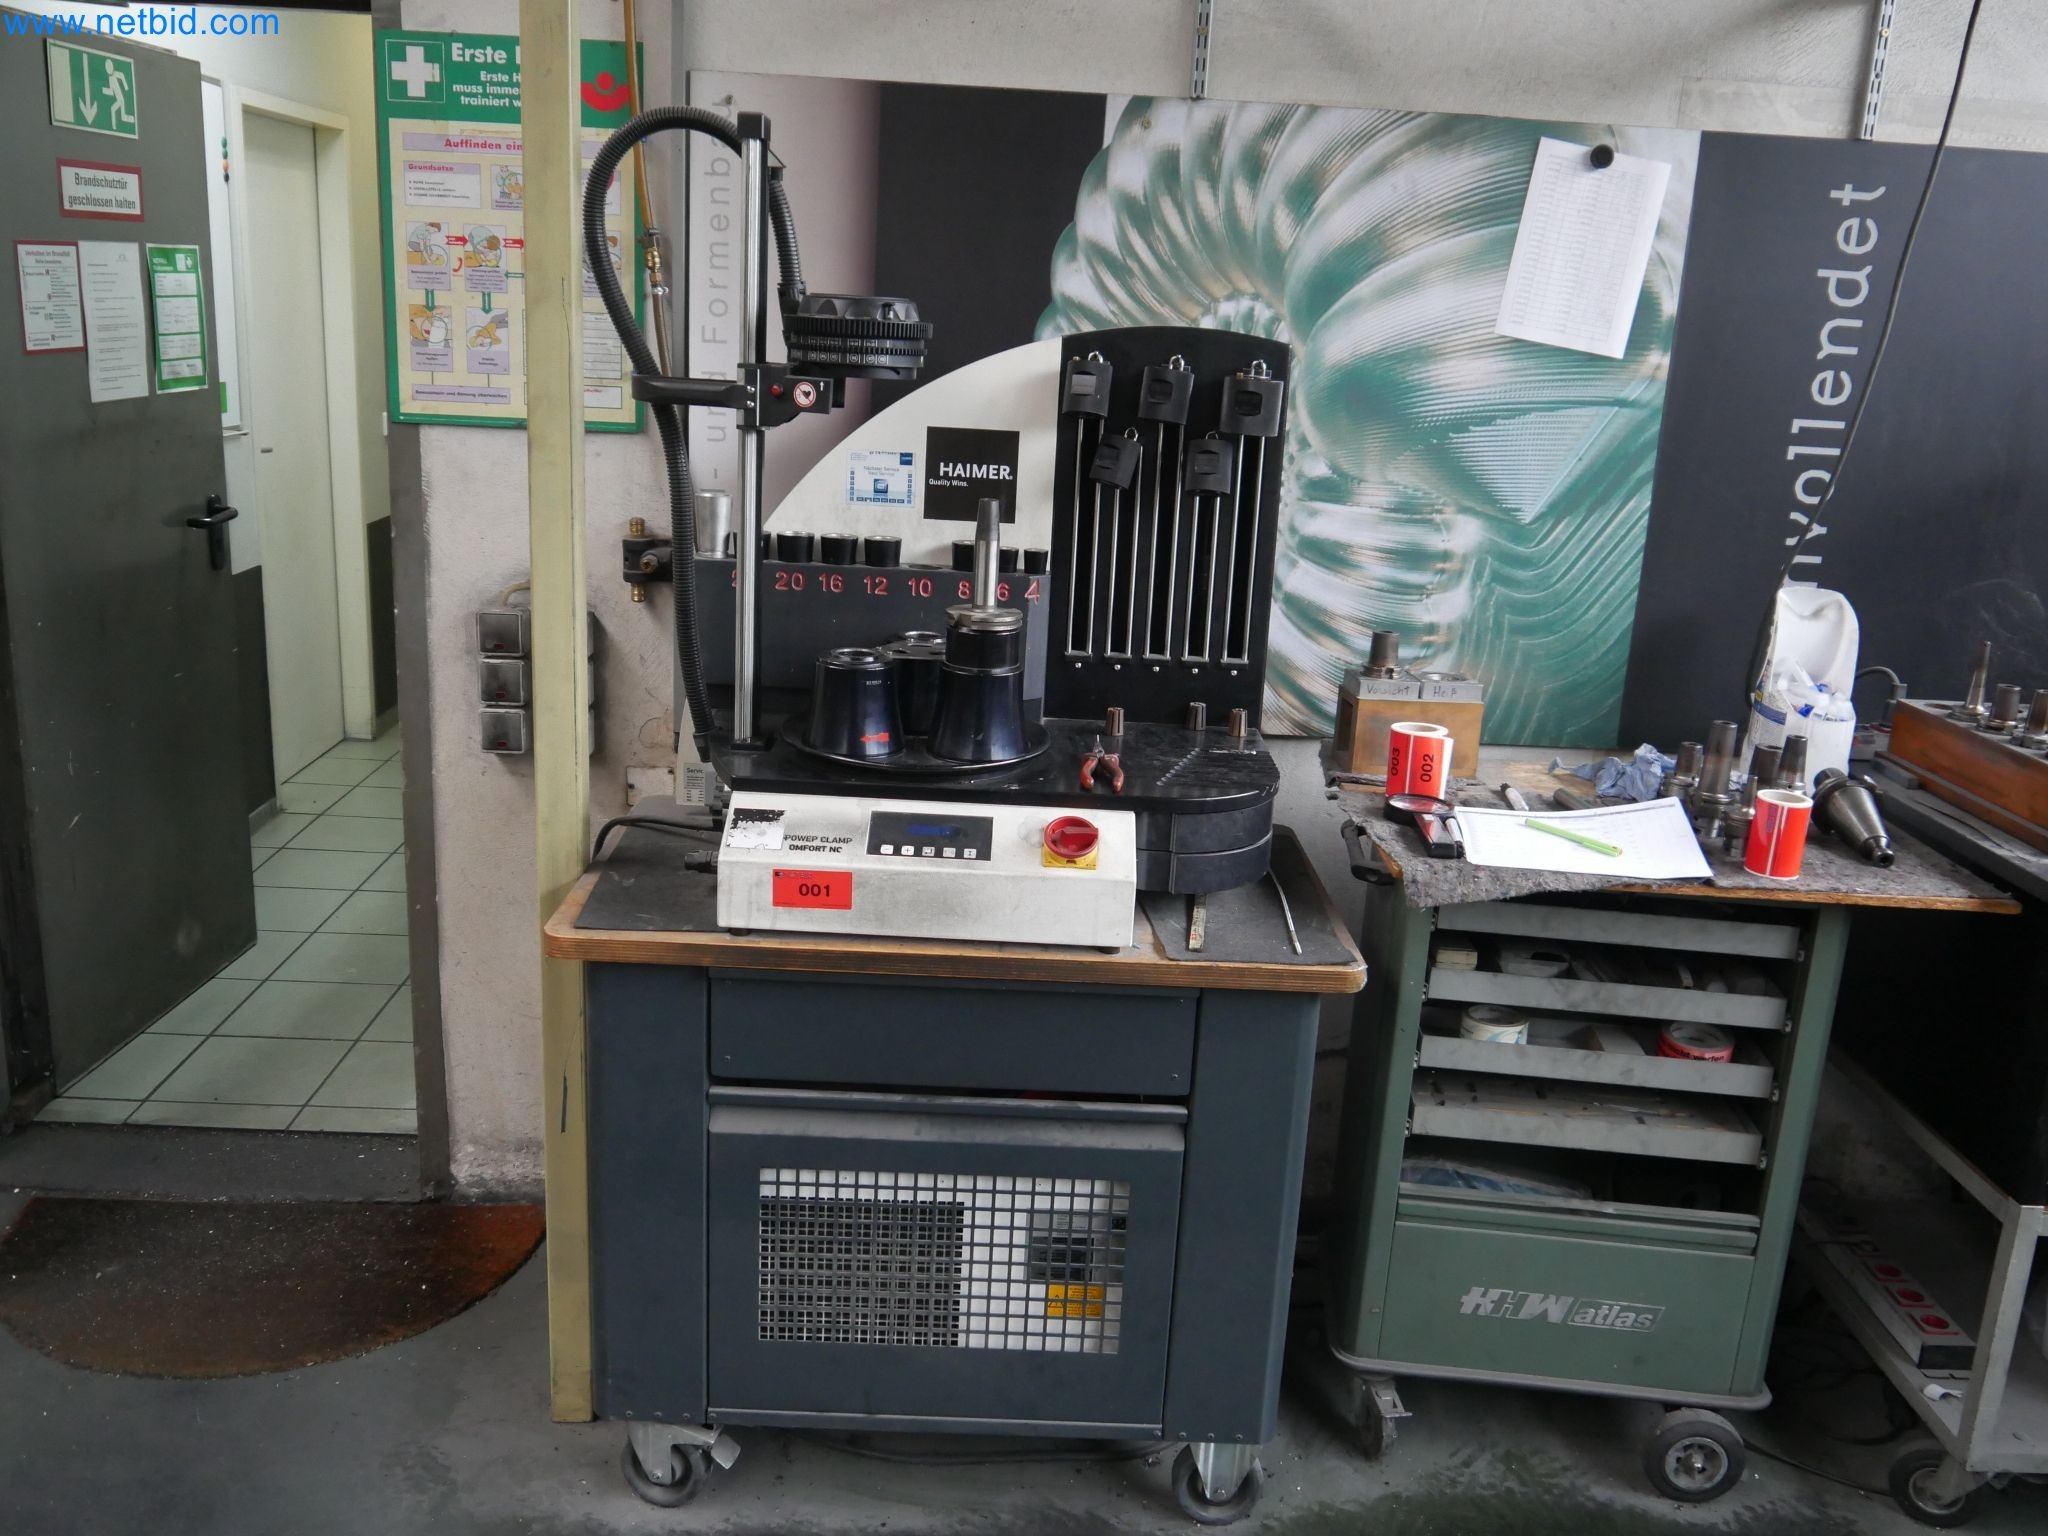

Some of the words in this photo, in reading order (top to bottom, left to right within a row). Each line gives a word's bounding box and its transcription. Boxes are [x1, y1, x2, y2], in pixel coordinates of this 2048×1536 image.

[451, 42, 508, 64] Erste
[480, 70, 510, 83] Erste
[452, 84, 484, 94] muss
[486, 83, 522, 95] imme
[460, 95, 510, 107] trainiert
[444, 138, 502, 150] Auffinden
[74, 171, 129, 190] Brandschutztür
[67, 193, 114, 208] geschlossen
[114, 196, 136, 210] halten
[928, 478, 951, 487] Quality
[951, 479, 969, 487] Wins.
[774, 569, 807, 592] 20
[818, 571, 845, 594] 16
[863, 574, 889, 596] 12
[908, 577, 933, 598] 10
[958, 579, 972, 600] 8
[996, 582, 1010, 602] 6
[1024, 577, 1041, 606] 4
[1366, 684, 1411, 697] Vosicht
[1390, 746, 1401, 777] 003
[1420, 753, 1434, 783] 002
[820, 836, 853, 845] CLAMP
[788, 845, 827, 853] OMFORT
[828, 845, 843, 854] NC
[798, 883, 831, 897] 001
[1573, 1305, 1654, 1329] atlas
